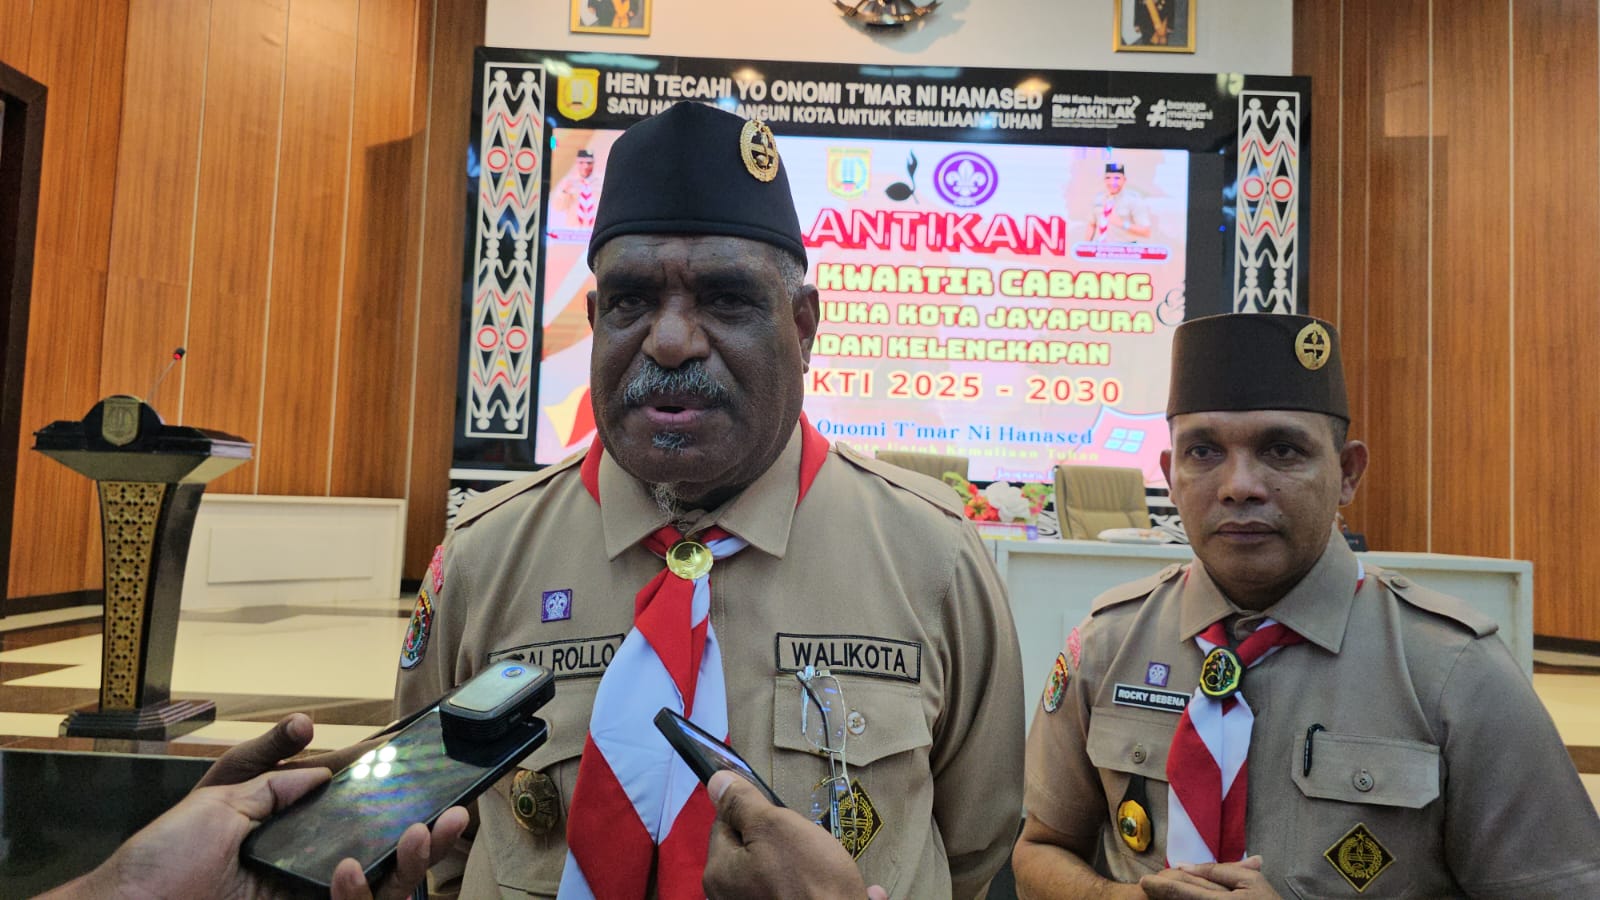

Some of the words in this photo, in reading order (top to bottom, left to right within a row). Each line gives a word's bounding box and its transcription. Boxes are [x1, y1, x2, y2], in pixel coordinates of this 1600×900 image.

[605, 72, 650, 95] HEN
[654, 74, 732, 99] TECAHI
[736, 79, 767, 102] YO
[771, 81, 841, 105] ONOMI
[846, 82, 911, 106] T'MAR
[916, 85, 938, 108] NI
[941, 86, 1043, 110] HANASED
[606, 97, 648, 115] SATU
[650, 99, 678, 115] HA
[794, 105, 836, 125] KOTA
[839, 107, 892, 126] UNTUK
[894, 109, 986, 129] KEMULIAAN
[988, 112, 1043, 130] TUHAN
[802, 208, 1066, 256] ANTIKAN
[816, 262, 994, 296] KWARTIR
[1000, 268, 1153, 301] CABANG
[897, 303, 980, 328] KOTA
[986, 307, 1155, 334] JAYAPURA
[887, 336, 1111, 365] KELENGKAPAN
[811, 370, 870, 395] KTI
[890, 373, 981, 399] 2025
[1029, 377, 1121, 403] 2030
[817, 418, 886, 438] Onomi
[894, 421, 961, 442] T'mar
[969, 425, 991, 442] Ni
[999, 426, 1092, 446] Hanased
[552, 642, 616, 672] ROLLO
[791, 641, 906, 674] WALIKOTA
[1117, 688, 1149, 702] ROCKY
[1149, 693, 1186, 708] BEBENA
